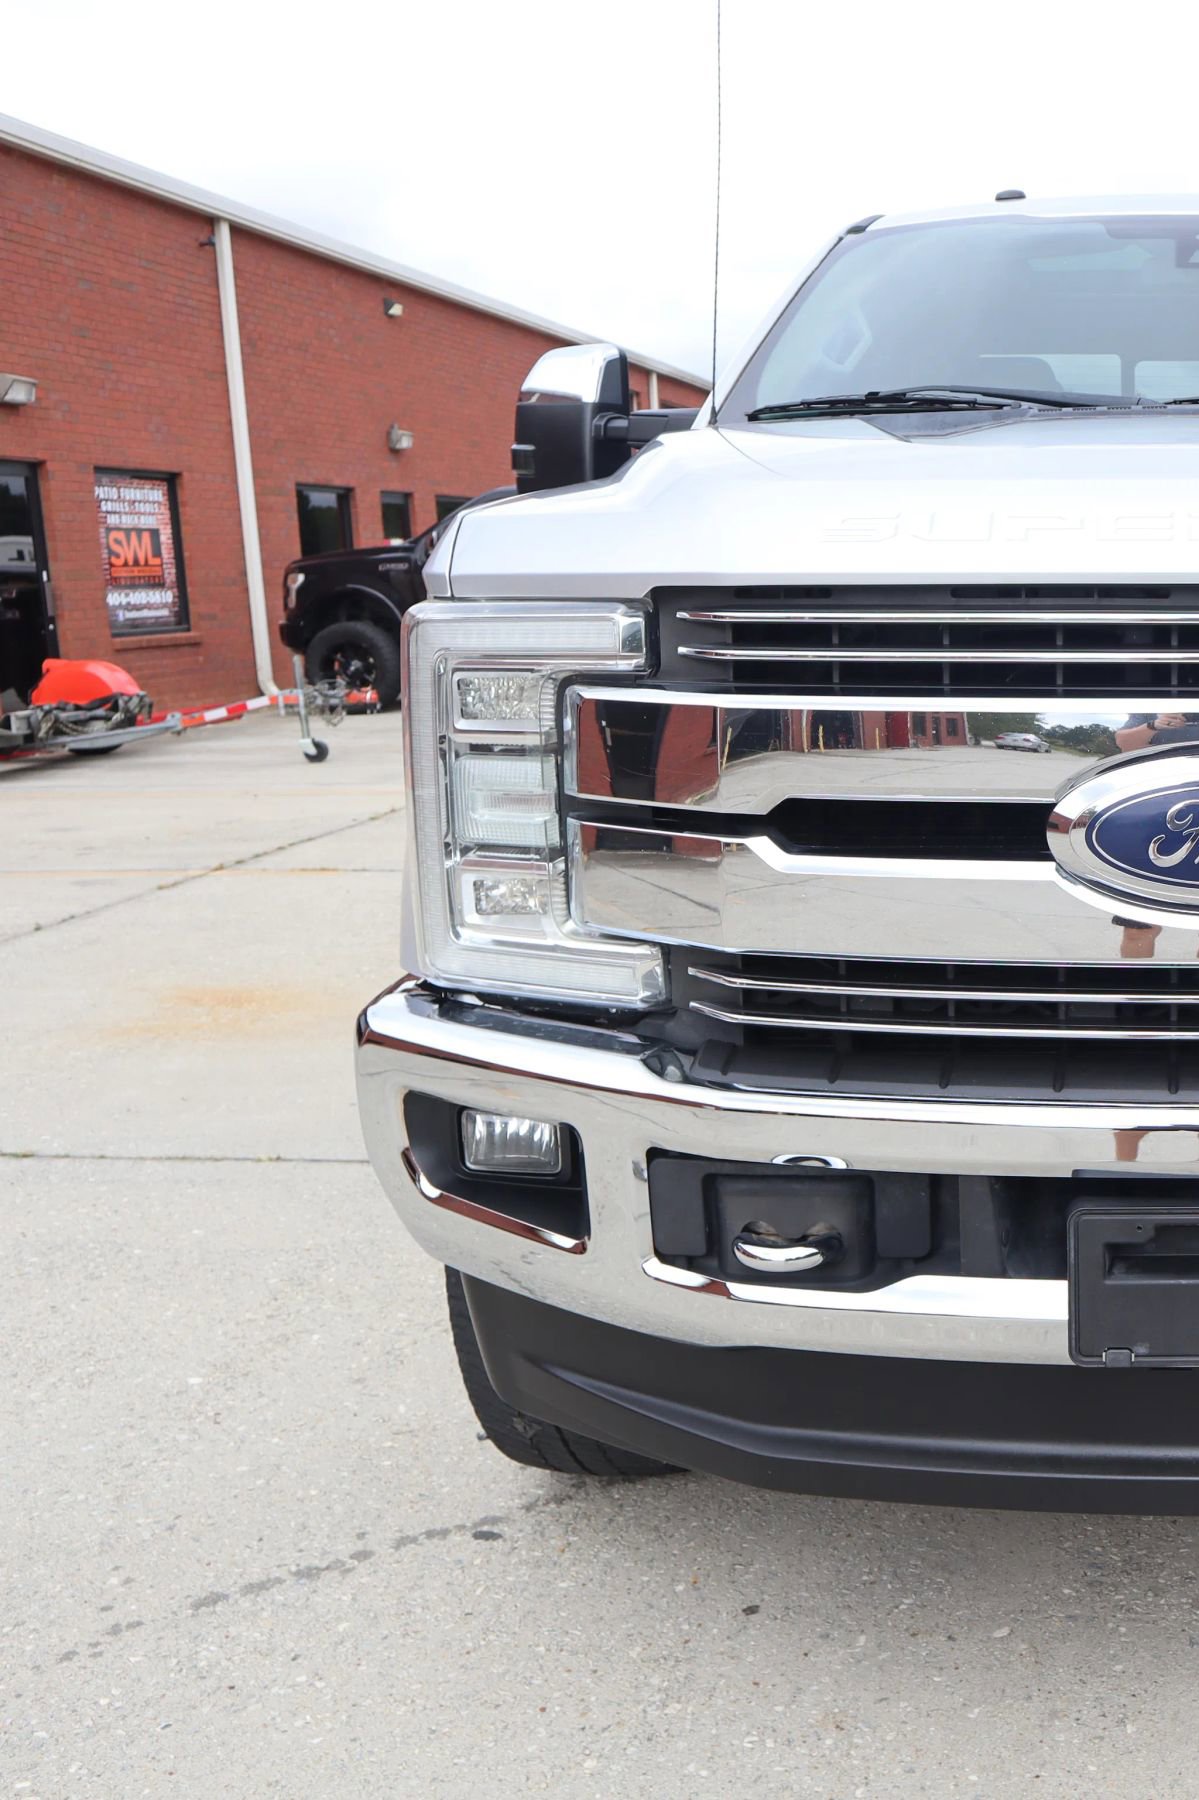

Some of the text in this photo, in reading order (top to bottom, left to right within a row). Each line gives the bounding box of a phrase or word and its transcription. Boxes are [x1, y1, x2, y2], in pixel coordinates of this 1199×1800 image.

[94, 486, 163, 502] PATIO FURNITURE
[101, 500, 129, 513] GRILLS
[108, 530, 162, 567] SWL
